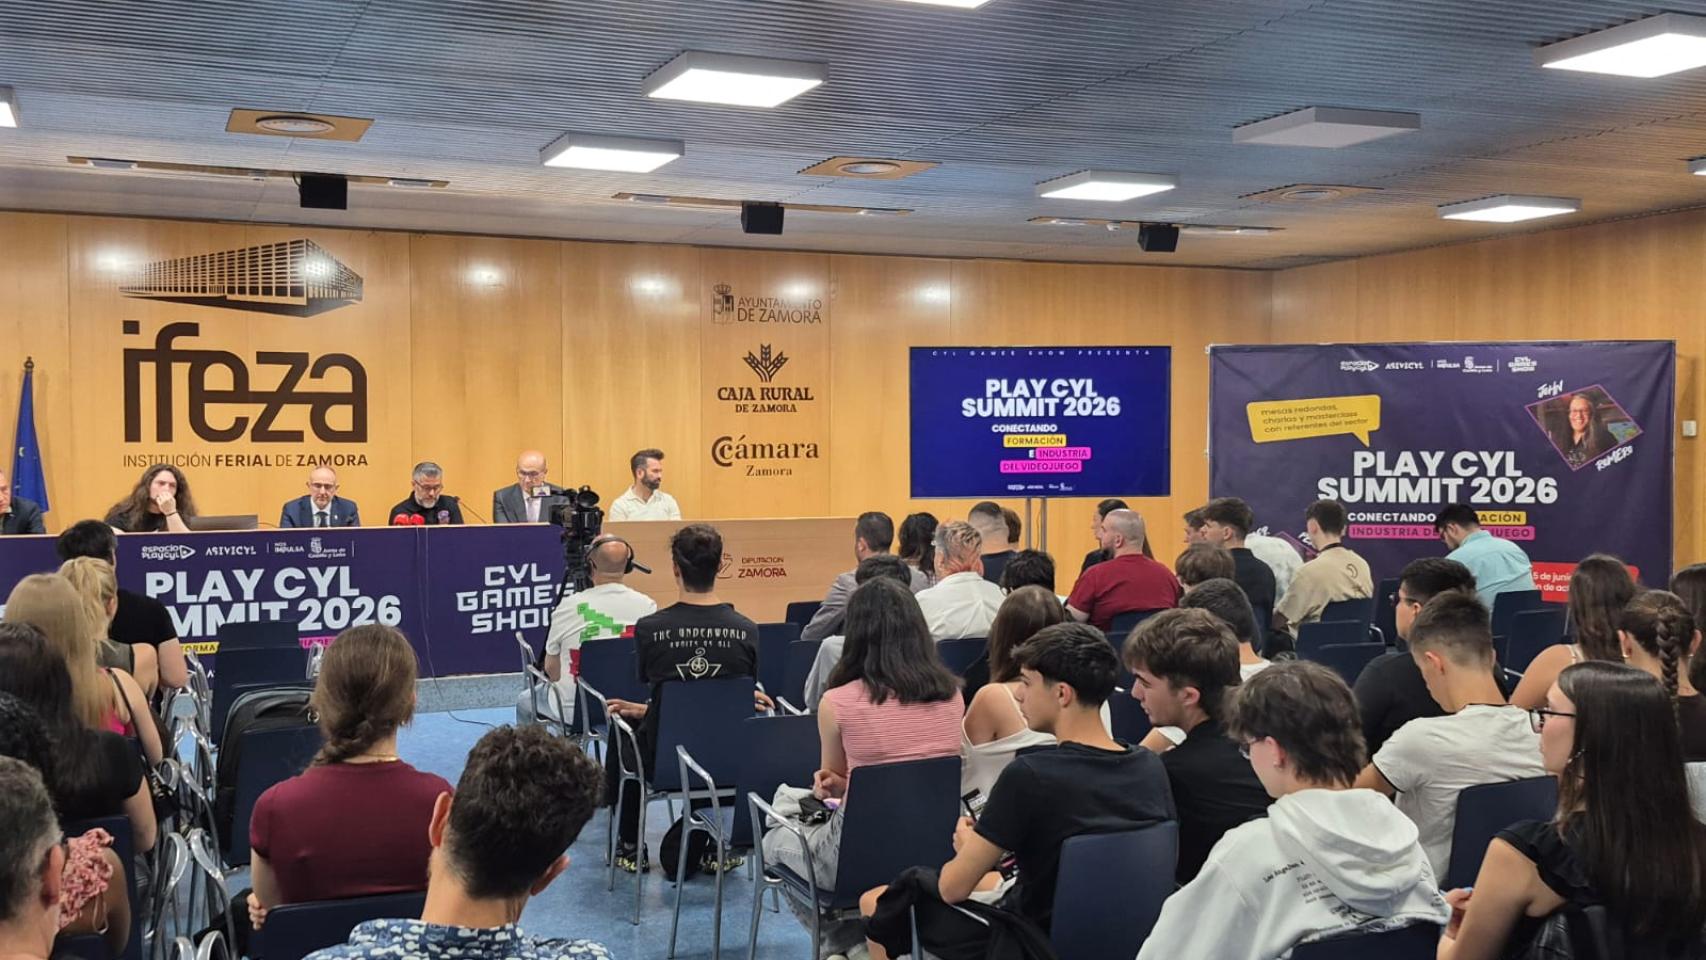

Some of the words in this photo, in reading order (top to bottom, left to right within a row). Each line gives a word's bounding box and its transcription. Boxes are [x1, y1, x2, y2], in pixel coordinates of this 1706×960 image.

[738, 307, 754, 321] DE
[759, 308, 822, 324] ZAMORA
[123, 320, 368, 443] ifeza
[986, 379, 1047, 398] PLAY
[1051, 379, 1098, 398] CYL
[717, 387, 757, 401] CAJA
[760, 387, 814, 401] RURAL
[735, 404, 749, 413] DE
[752, 403, 798, 413] ZAMORA
[962, 397, 1059, 417] SUMMIT
[1063, 397, 1121, 416] 2026
[991, 424, 1058, 432] CONECTANDO
[123, 453, 211, 467] INSTITUCIÓN
[215, 454, 272, 467] FERIAL
[276, 455, 293, 467] DE
[296, 454, 369, 467] ZAMORA
[1029, 450, 1035, 458] E
[1039, 449, 1088, 458] INDUSTRIA
[746, 465, 793, 477] Zamora
[1003, 463, 1020, 471] DEL
[1021, 462, 1079, 471] VIDEOJUEGO
[1353, 451, 1445, 477] PLAY
[1451, 451, 1523, 477] CYL
[1317, 478, 1464, 503] SUMMIT
[1470, 477, 1559, 504] 2026
[1347, 512, 1437, 522] CONECTANDO
[1352, 527, 1419, 536] INDUSTRIA
[205, 546, 257, 556] ASIVICYL
[484, 563, 551, 586] CYL
[738, 567, 787, 578] ZAMORA
[146, 569, 265, 603] PLAY
[273, 566, 360, 599] CYL
[298, 595, 402, 631] 2026
